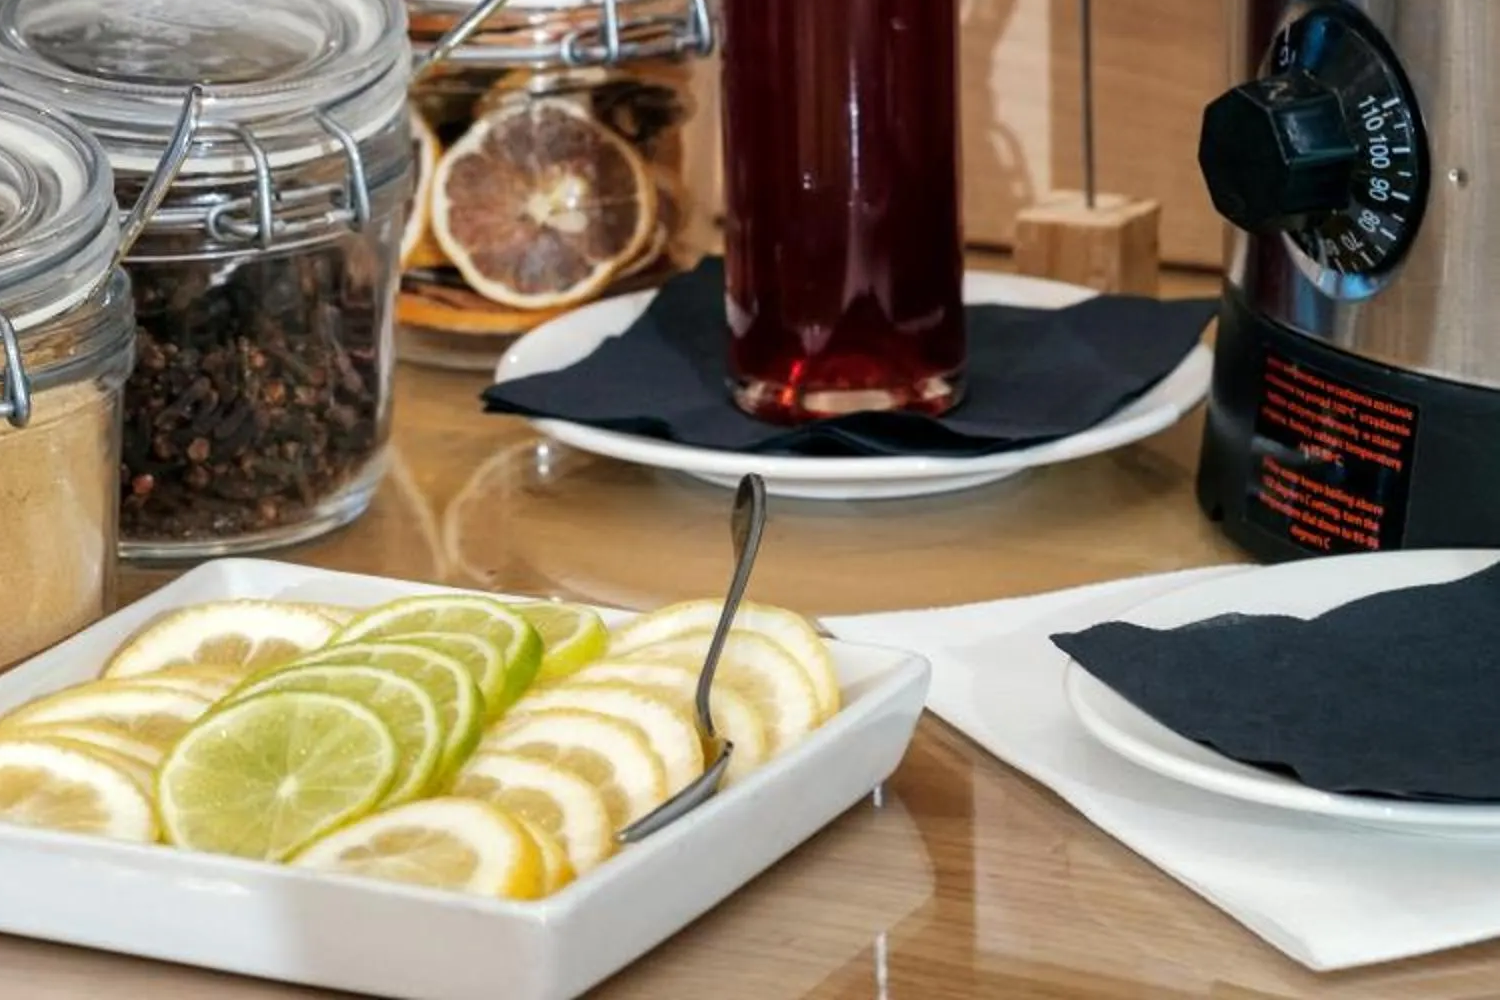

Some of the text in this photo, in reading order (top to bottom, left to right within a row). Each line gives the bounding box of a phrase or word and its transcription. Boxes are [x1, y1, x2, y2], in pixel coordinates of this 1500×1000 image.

[1358, 95, 1385, 131] 110
[1368, 134, 1391, 169] 100
[1368, 176, 1390, 202] 90
[1358, 209, 1381, 233] 80
